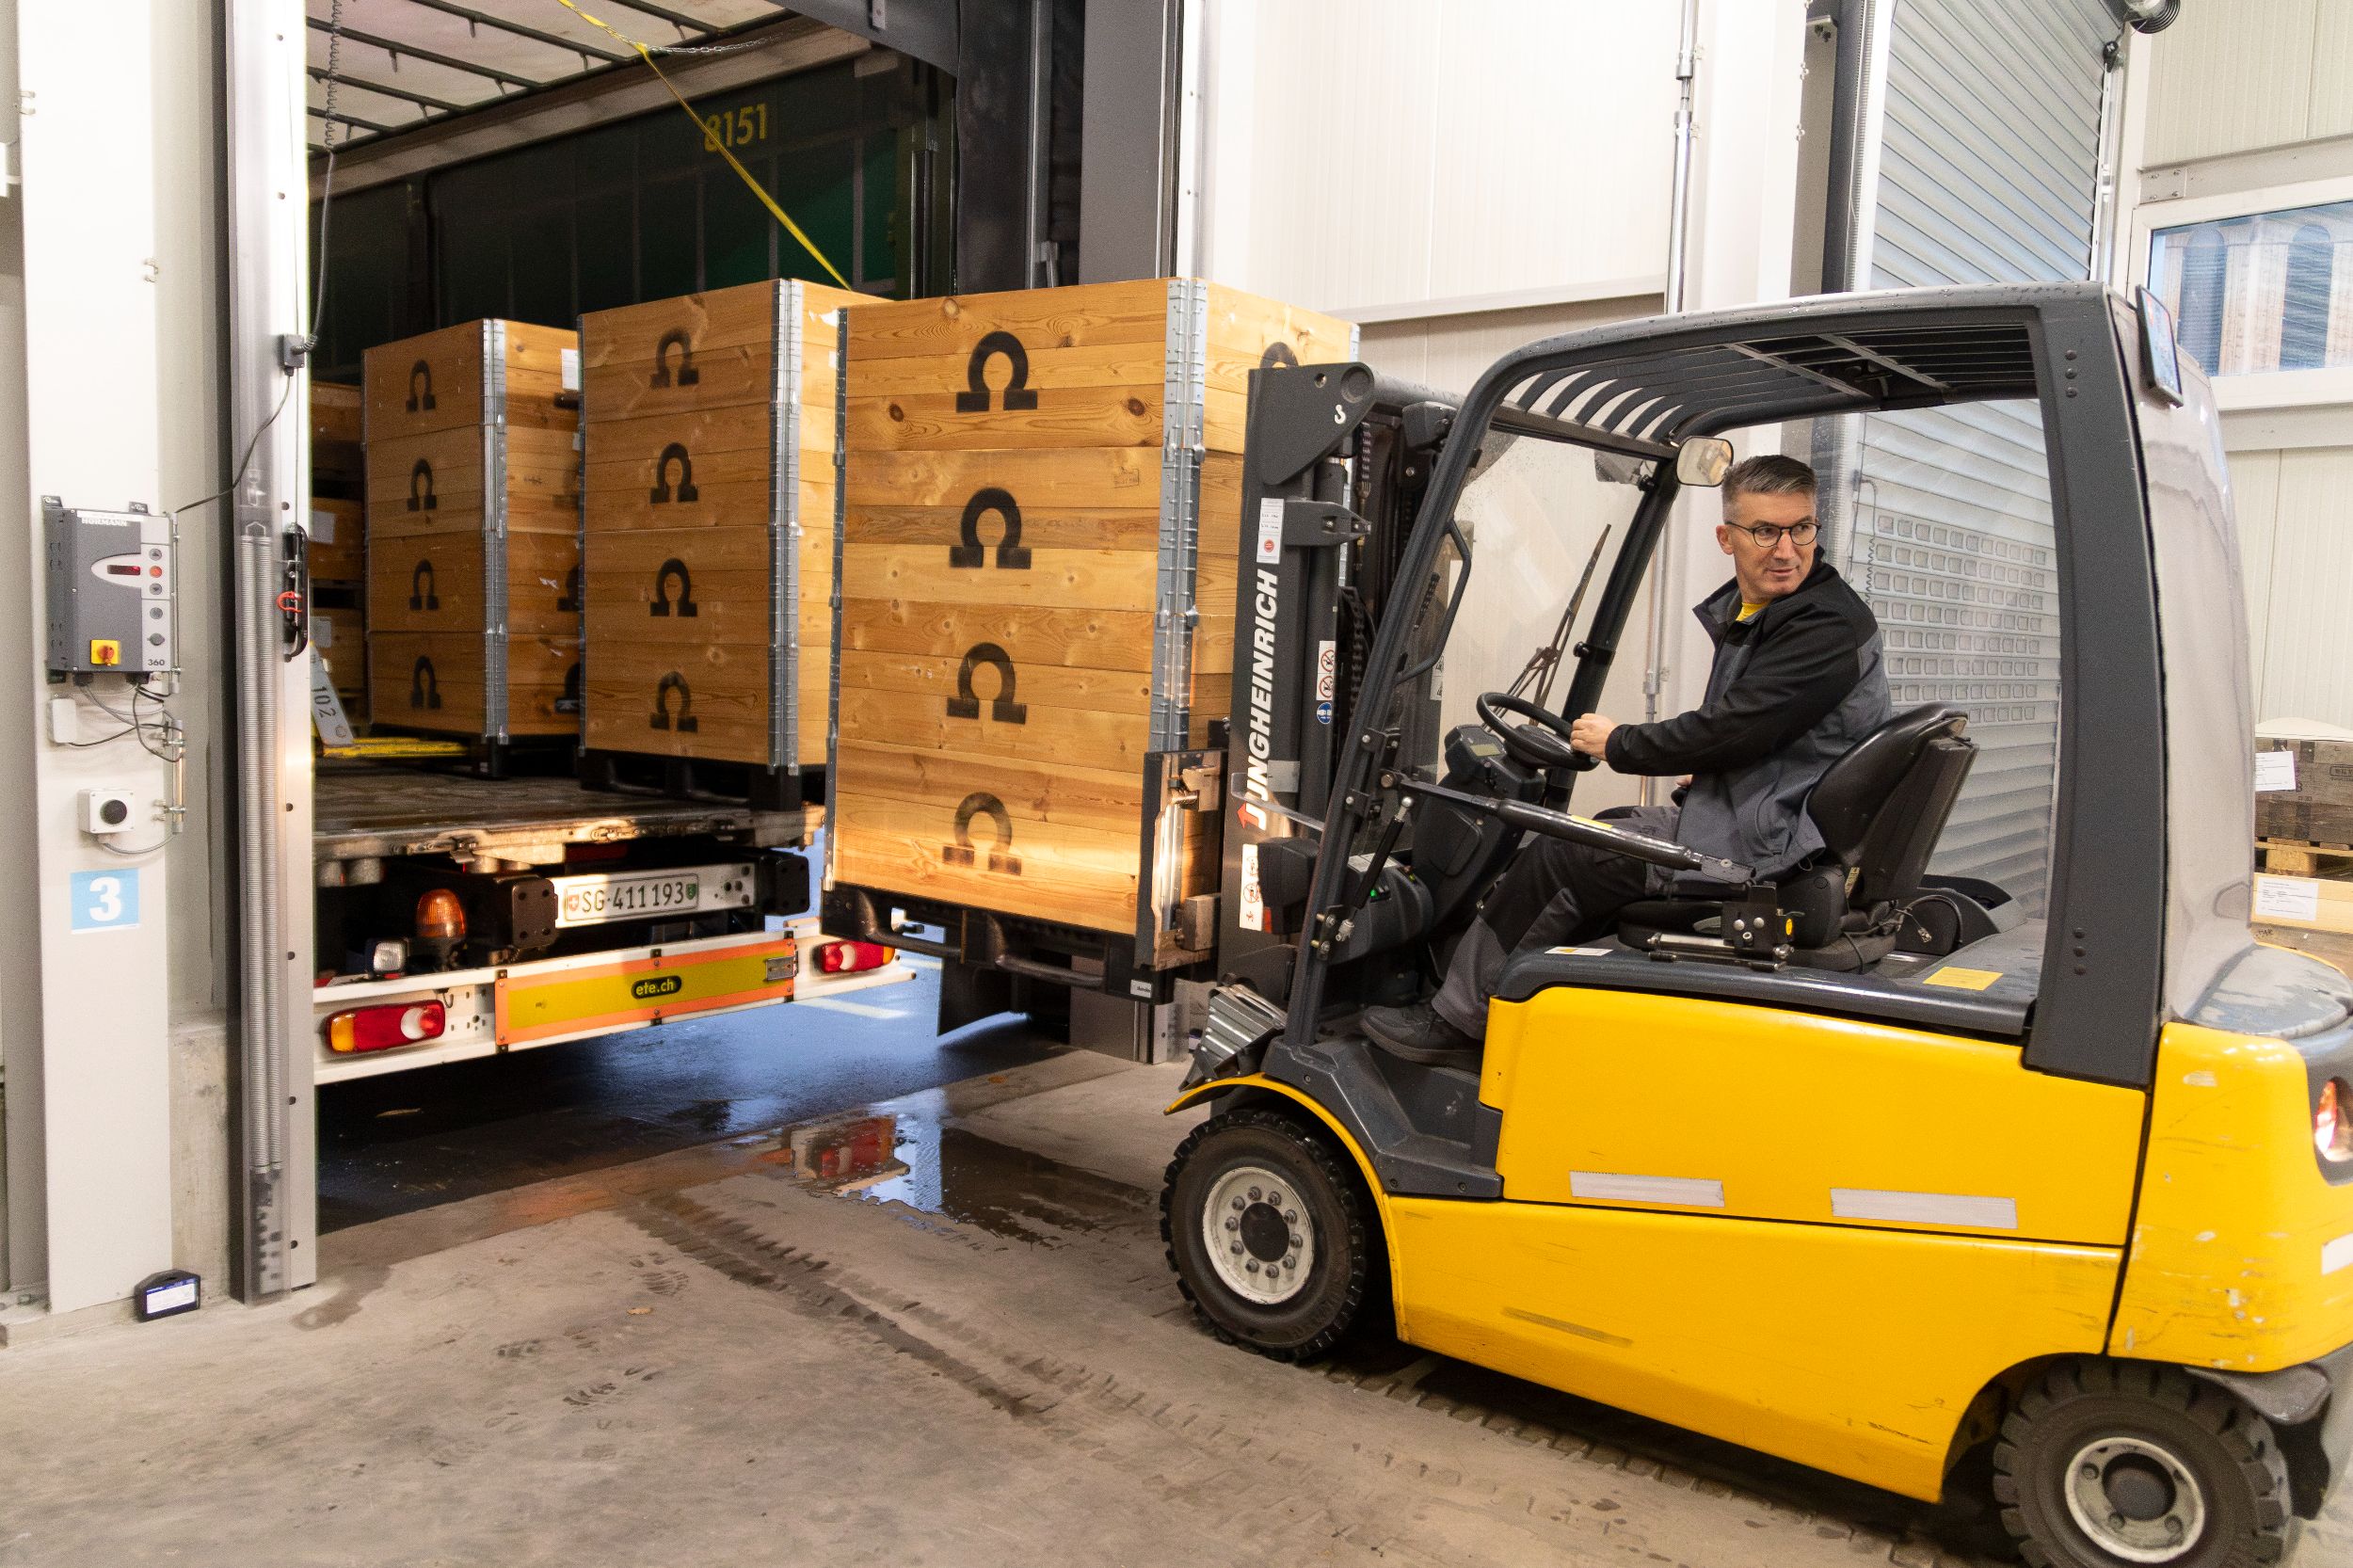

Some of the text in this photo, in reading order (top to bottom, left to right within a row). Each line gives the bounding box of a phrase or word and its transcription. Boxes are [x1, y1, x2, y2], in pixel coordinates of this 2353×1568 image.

[704, 103, 767, 152] 8151
[1238, 568, 1278, 830] JUNGHEINRICH
[89, 876, 121, 921] 3
[635, 979, 675, 997] ete.ch
